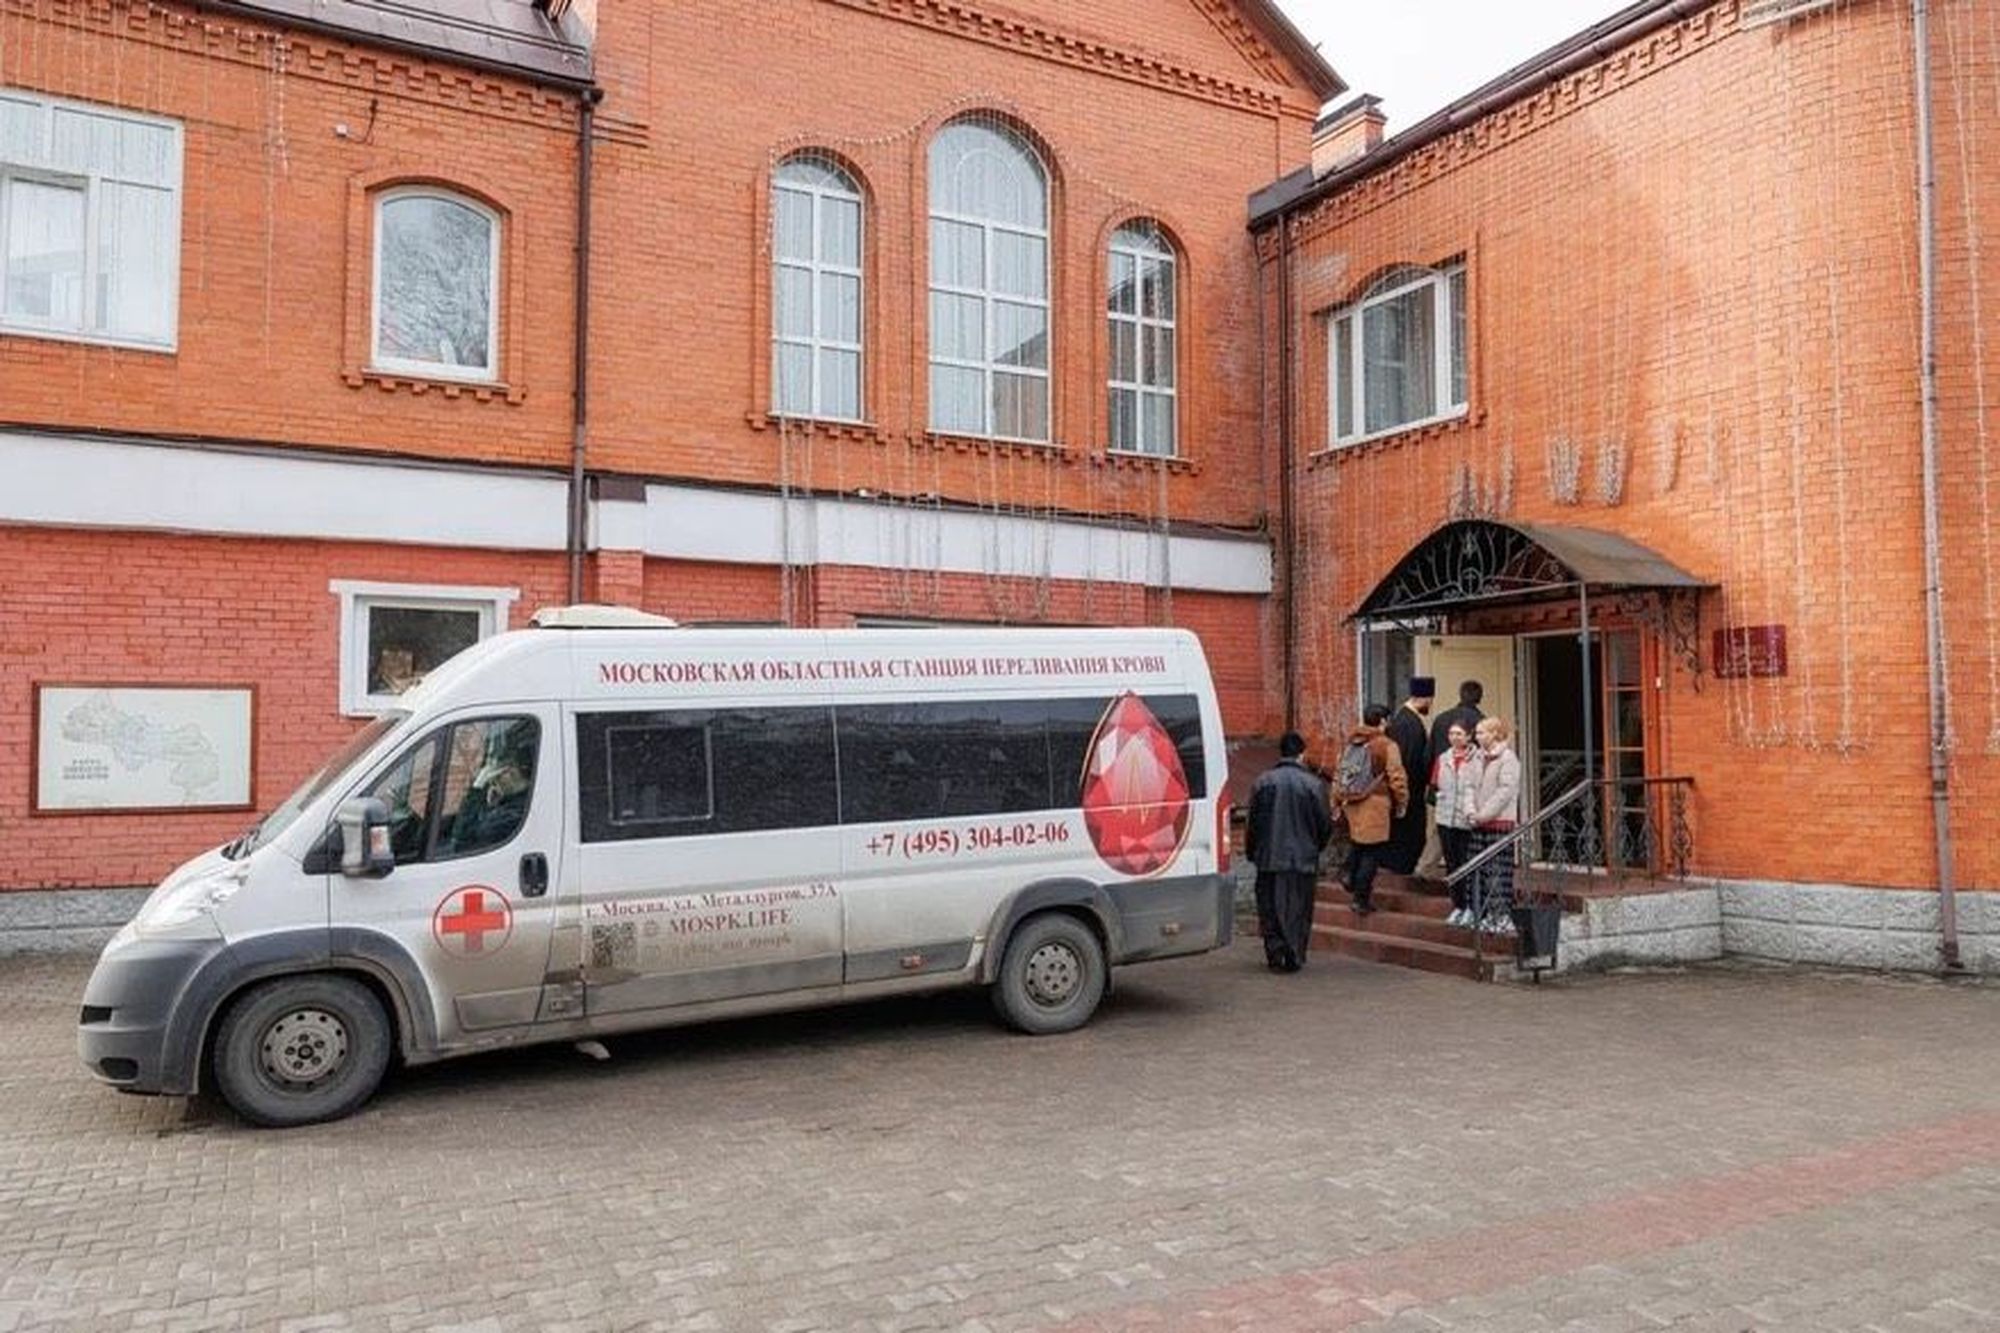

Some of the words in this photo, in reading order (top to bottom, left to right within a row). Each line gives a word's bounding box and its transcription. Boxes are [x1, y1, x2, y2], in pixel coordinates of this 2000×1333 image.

[600, 662, 755, 683] МОСКОВСКАЯ
[760, 659, 883, 681] ОБЛАСТНАЯ
[888, 658, 977, 679] СТАНЦИЯ
[982, 656, 1109, 677] ПЕРЕЛИВАНИЯ
[1111, 655, 1166, 673] КРОВИ
[866, 833, 895, 856] +7
[903, 829, 959, 858] (495)
[966, 822, 1069, 849] 304-02-06
[809, 882, 838, 899] 37А
[669, 908, 793, 935] MOSPK.LIFE
